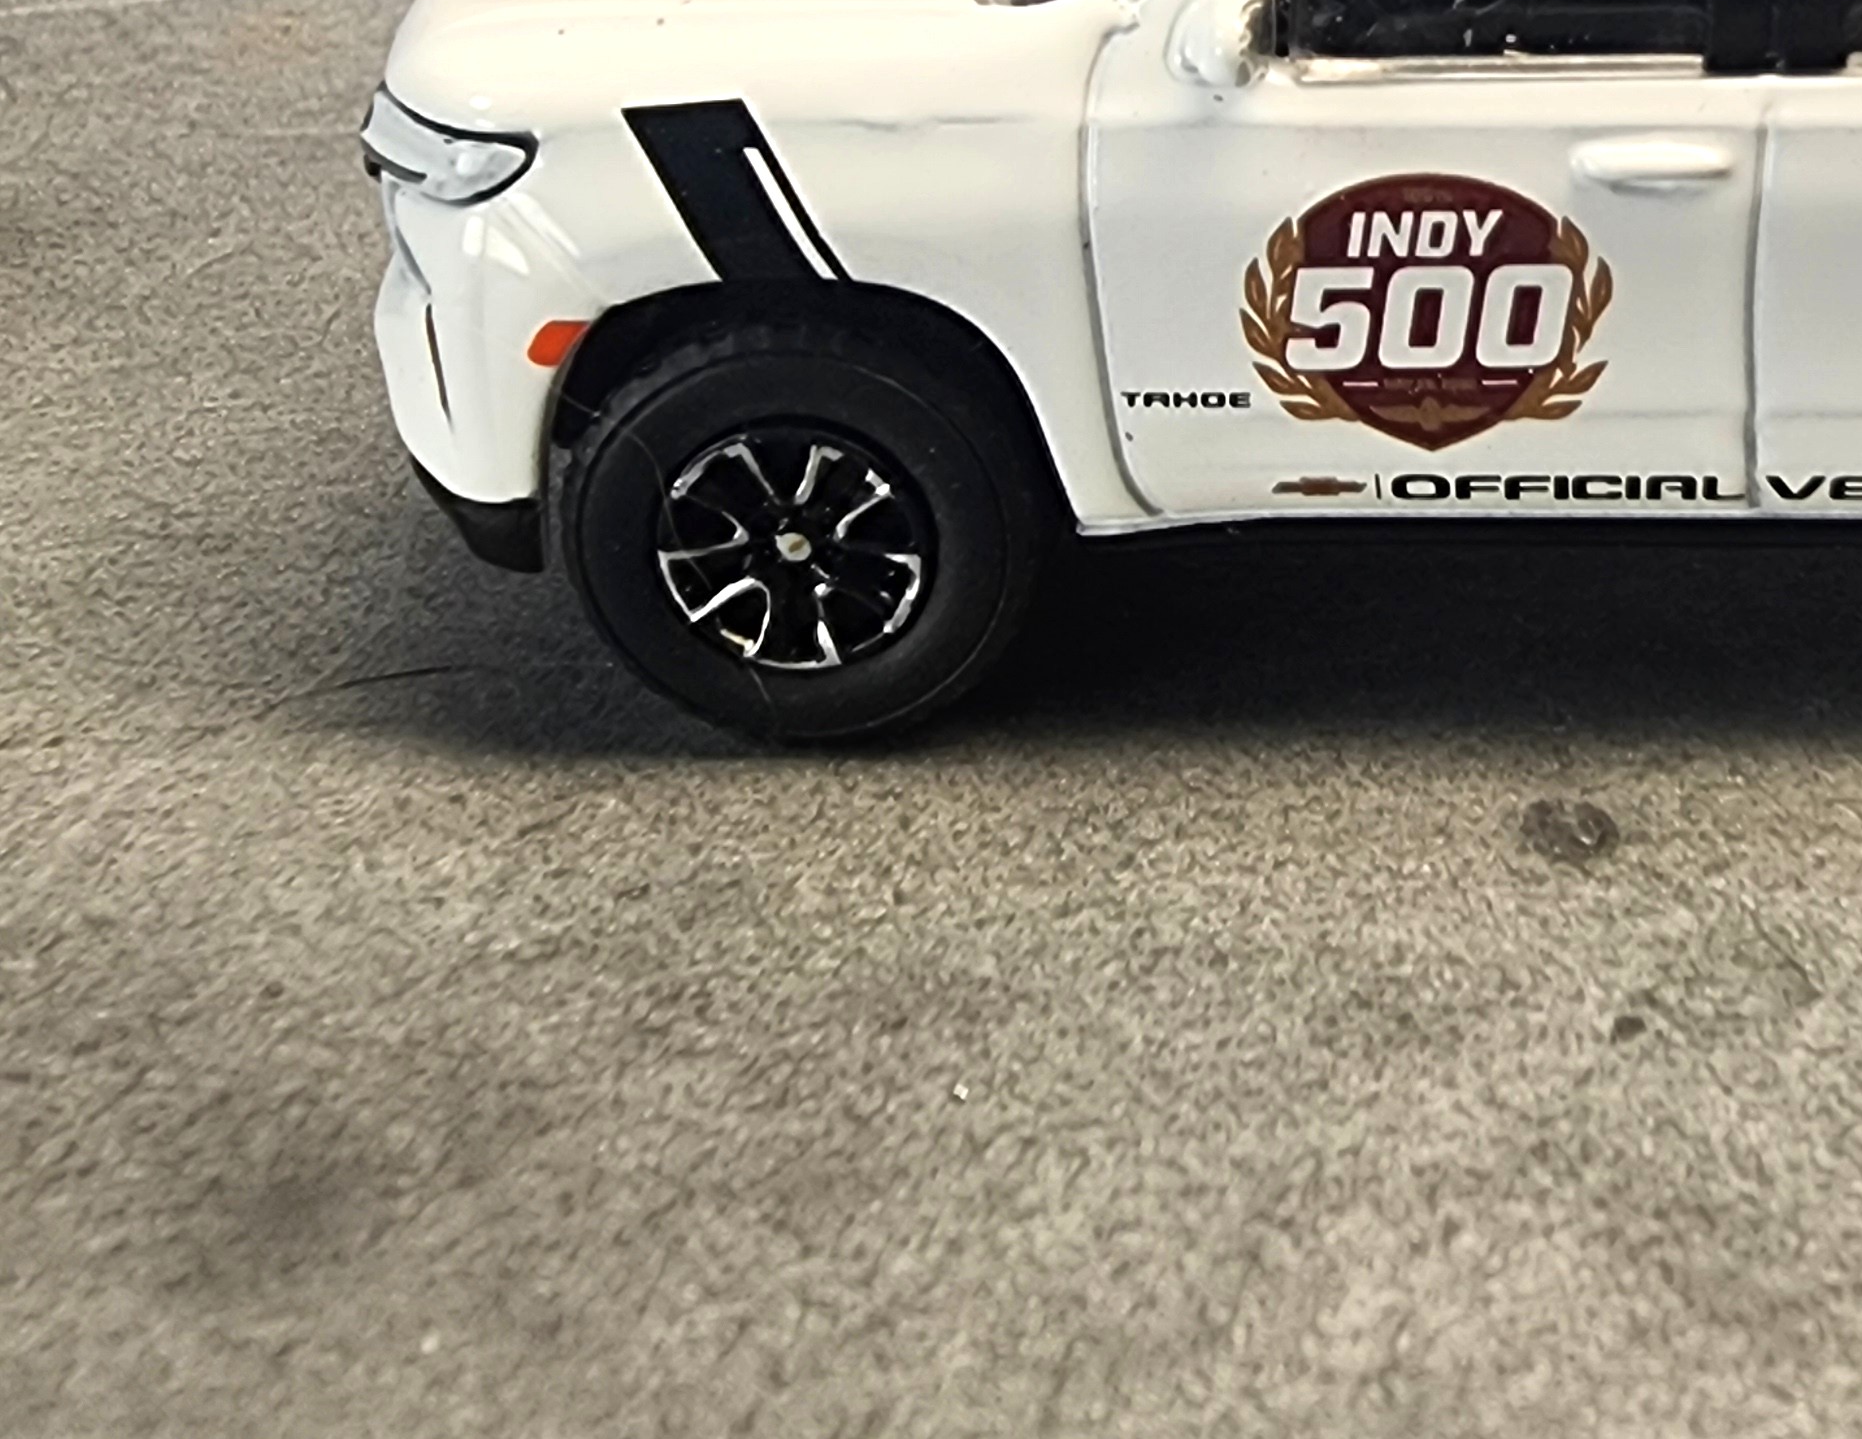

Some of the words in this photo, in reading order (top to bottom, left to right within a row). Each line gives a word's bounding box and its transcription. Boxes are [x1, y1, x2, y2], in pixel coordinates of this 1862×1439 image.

[1347, 210, 1503, 258] INDY
[1285, 264, 1574, 371] 500
[1120, 391, 1252, 408] TAHOE
[1390, 473, 1745, 500] OFFICIAL
